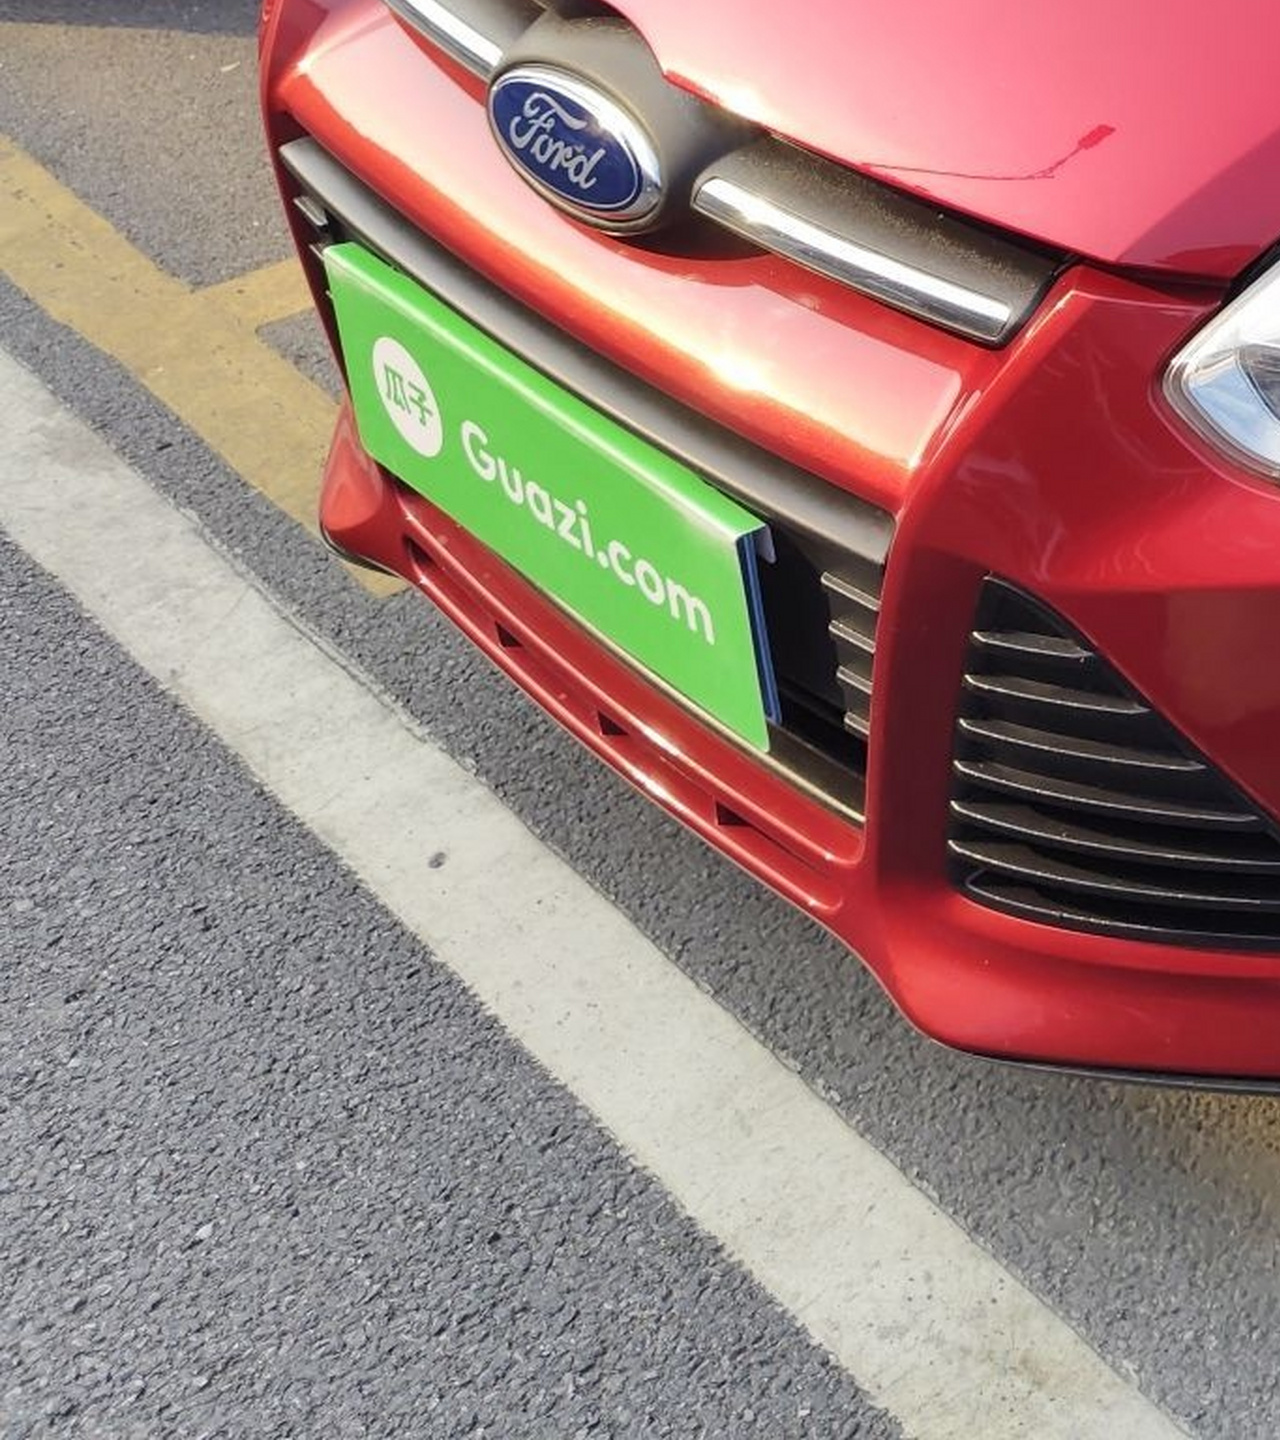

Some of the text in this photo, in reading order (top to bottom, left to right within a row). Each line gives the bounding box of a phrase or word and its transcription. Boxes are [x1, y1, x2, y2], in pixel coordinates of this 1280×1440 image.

[510, 92, 605, 190] Ford
[383, 362, 434, 427] 瓜子
[460, 419, 715, 645] Guazi.com
